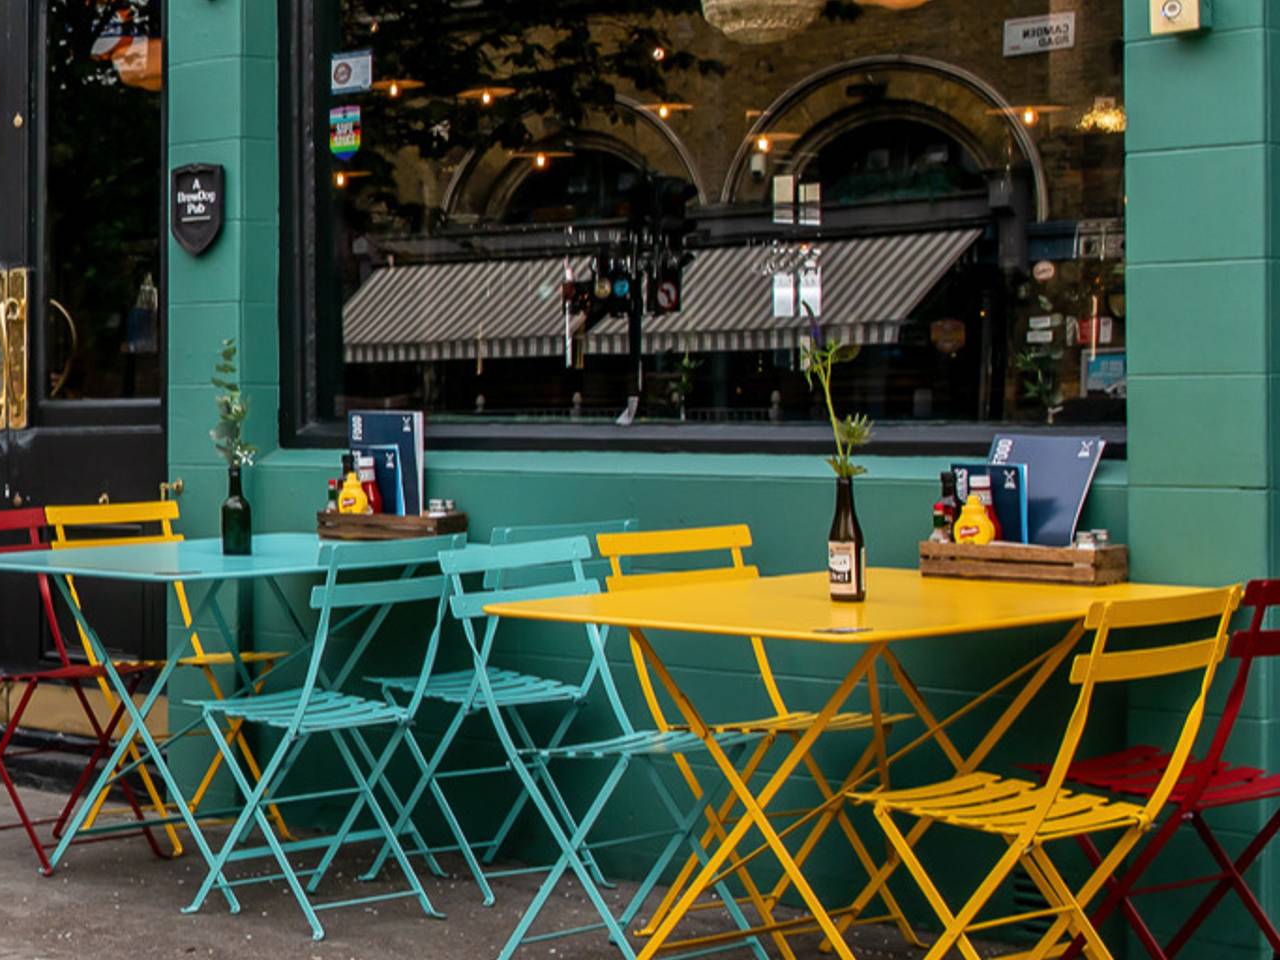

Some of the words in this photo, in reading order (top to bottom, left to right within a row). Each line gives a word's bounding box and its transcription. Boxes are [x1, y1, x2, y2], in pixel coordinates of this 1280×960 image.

[192, 178, 201, 190] A
[177, 190, 216, 204] BrewDog
[187, 203, 206, 215] Pub
